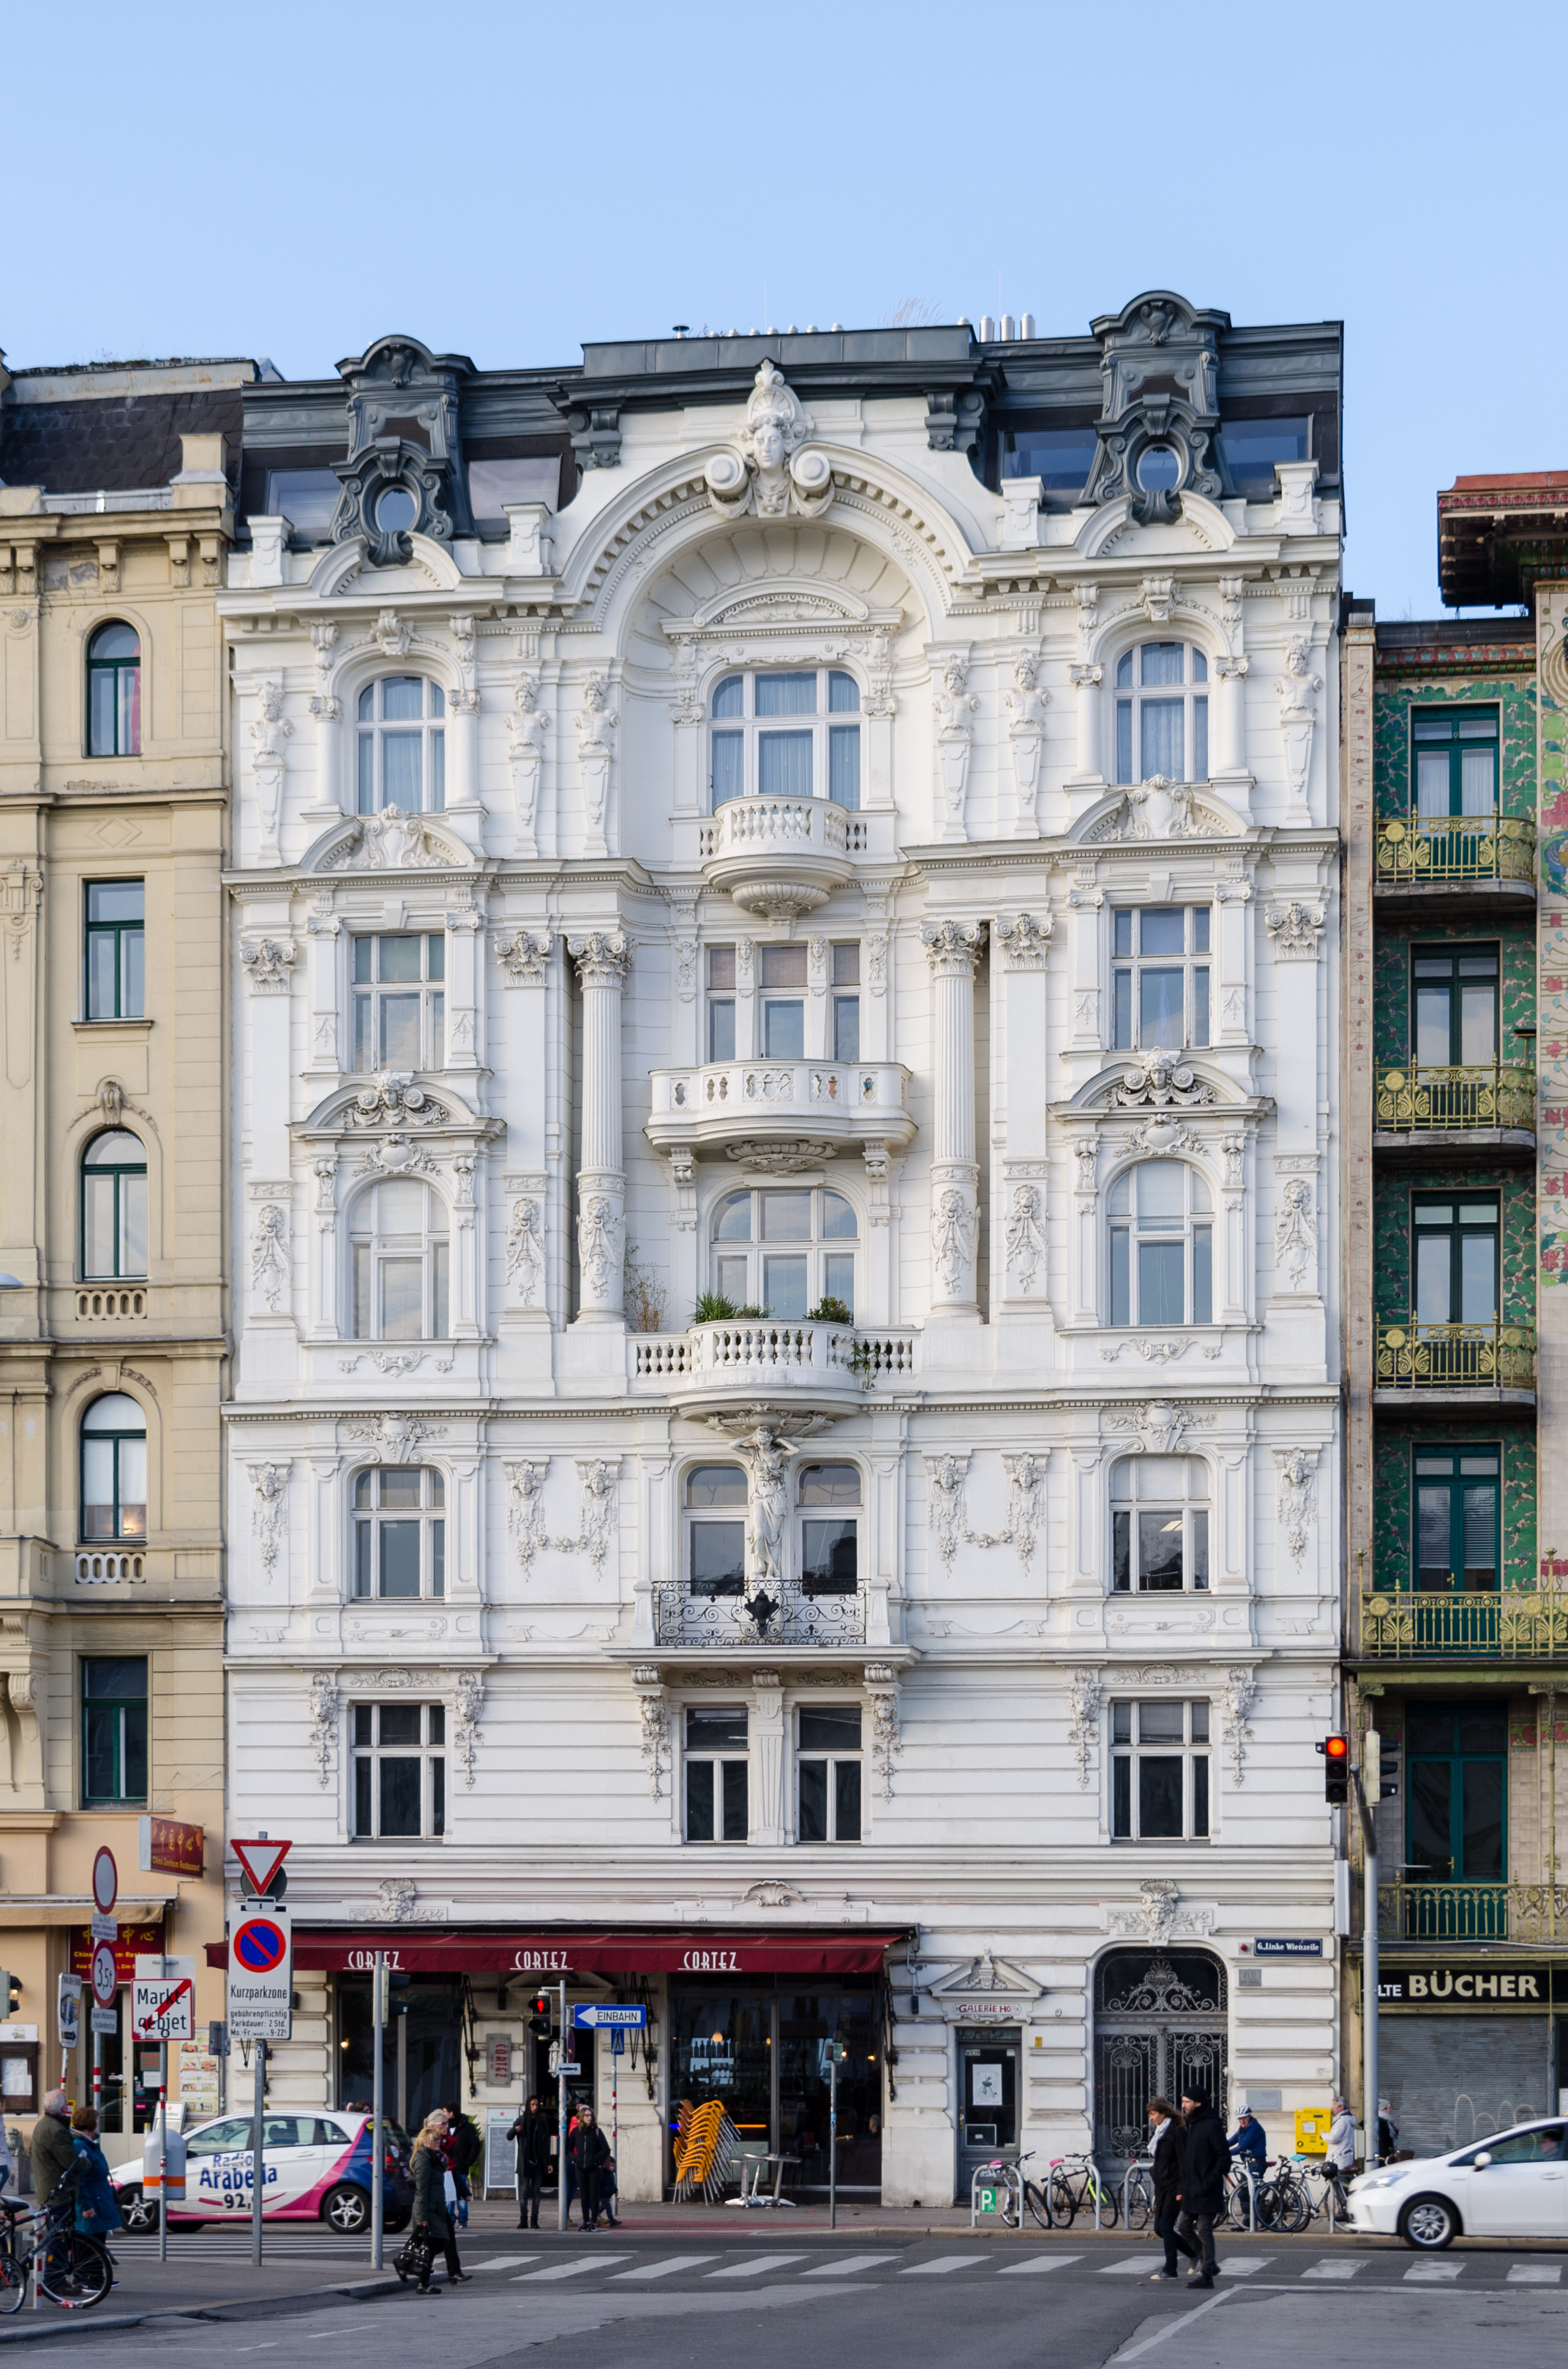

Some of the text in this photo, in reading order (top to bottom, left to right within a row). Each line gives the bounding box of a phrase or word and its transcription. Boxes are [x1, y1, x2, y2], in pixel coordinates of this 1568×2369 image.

[152, 1855, 163, 1865] China
[180, 1861, 200, 1871] Restaurant
[82, 1925, 157, 1946] 中中心
[1286, 1942, 1319, 1951] Wienzeile
[348, 1951, 399, 1968] COREZ
[515, 1951, 568, 1969] CORTEZ
[683, 1951, 737, 1969] CORTEZ
[1378, 1970, 1540, 1997] LTE BÜCHER
[138, 1988, 187, 2005] Markt-
[230, 1984, 288, 2001] Kurzparkzone
[230, 2010, 288, 2019] gebührenpflichtig
[231, 2019, 266, 2027] Parkdauer:
[597, 2011, 637, 2021] EINBAHN
[495, 2043, 507, 2078] CORTEZ
[213, 2153, 252, 2168] Radio
[200, 2163, 277, 2190] Arabela
[224, 2193, 254, 2210] 92,
[981, 2189, 993, 2211] P
